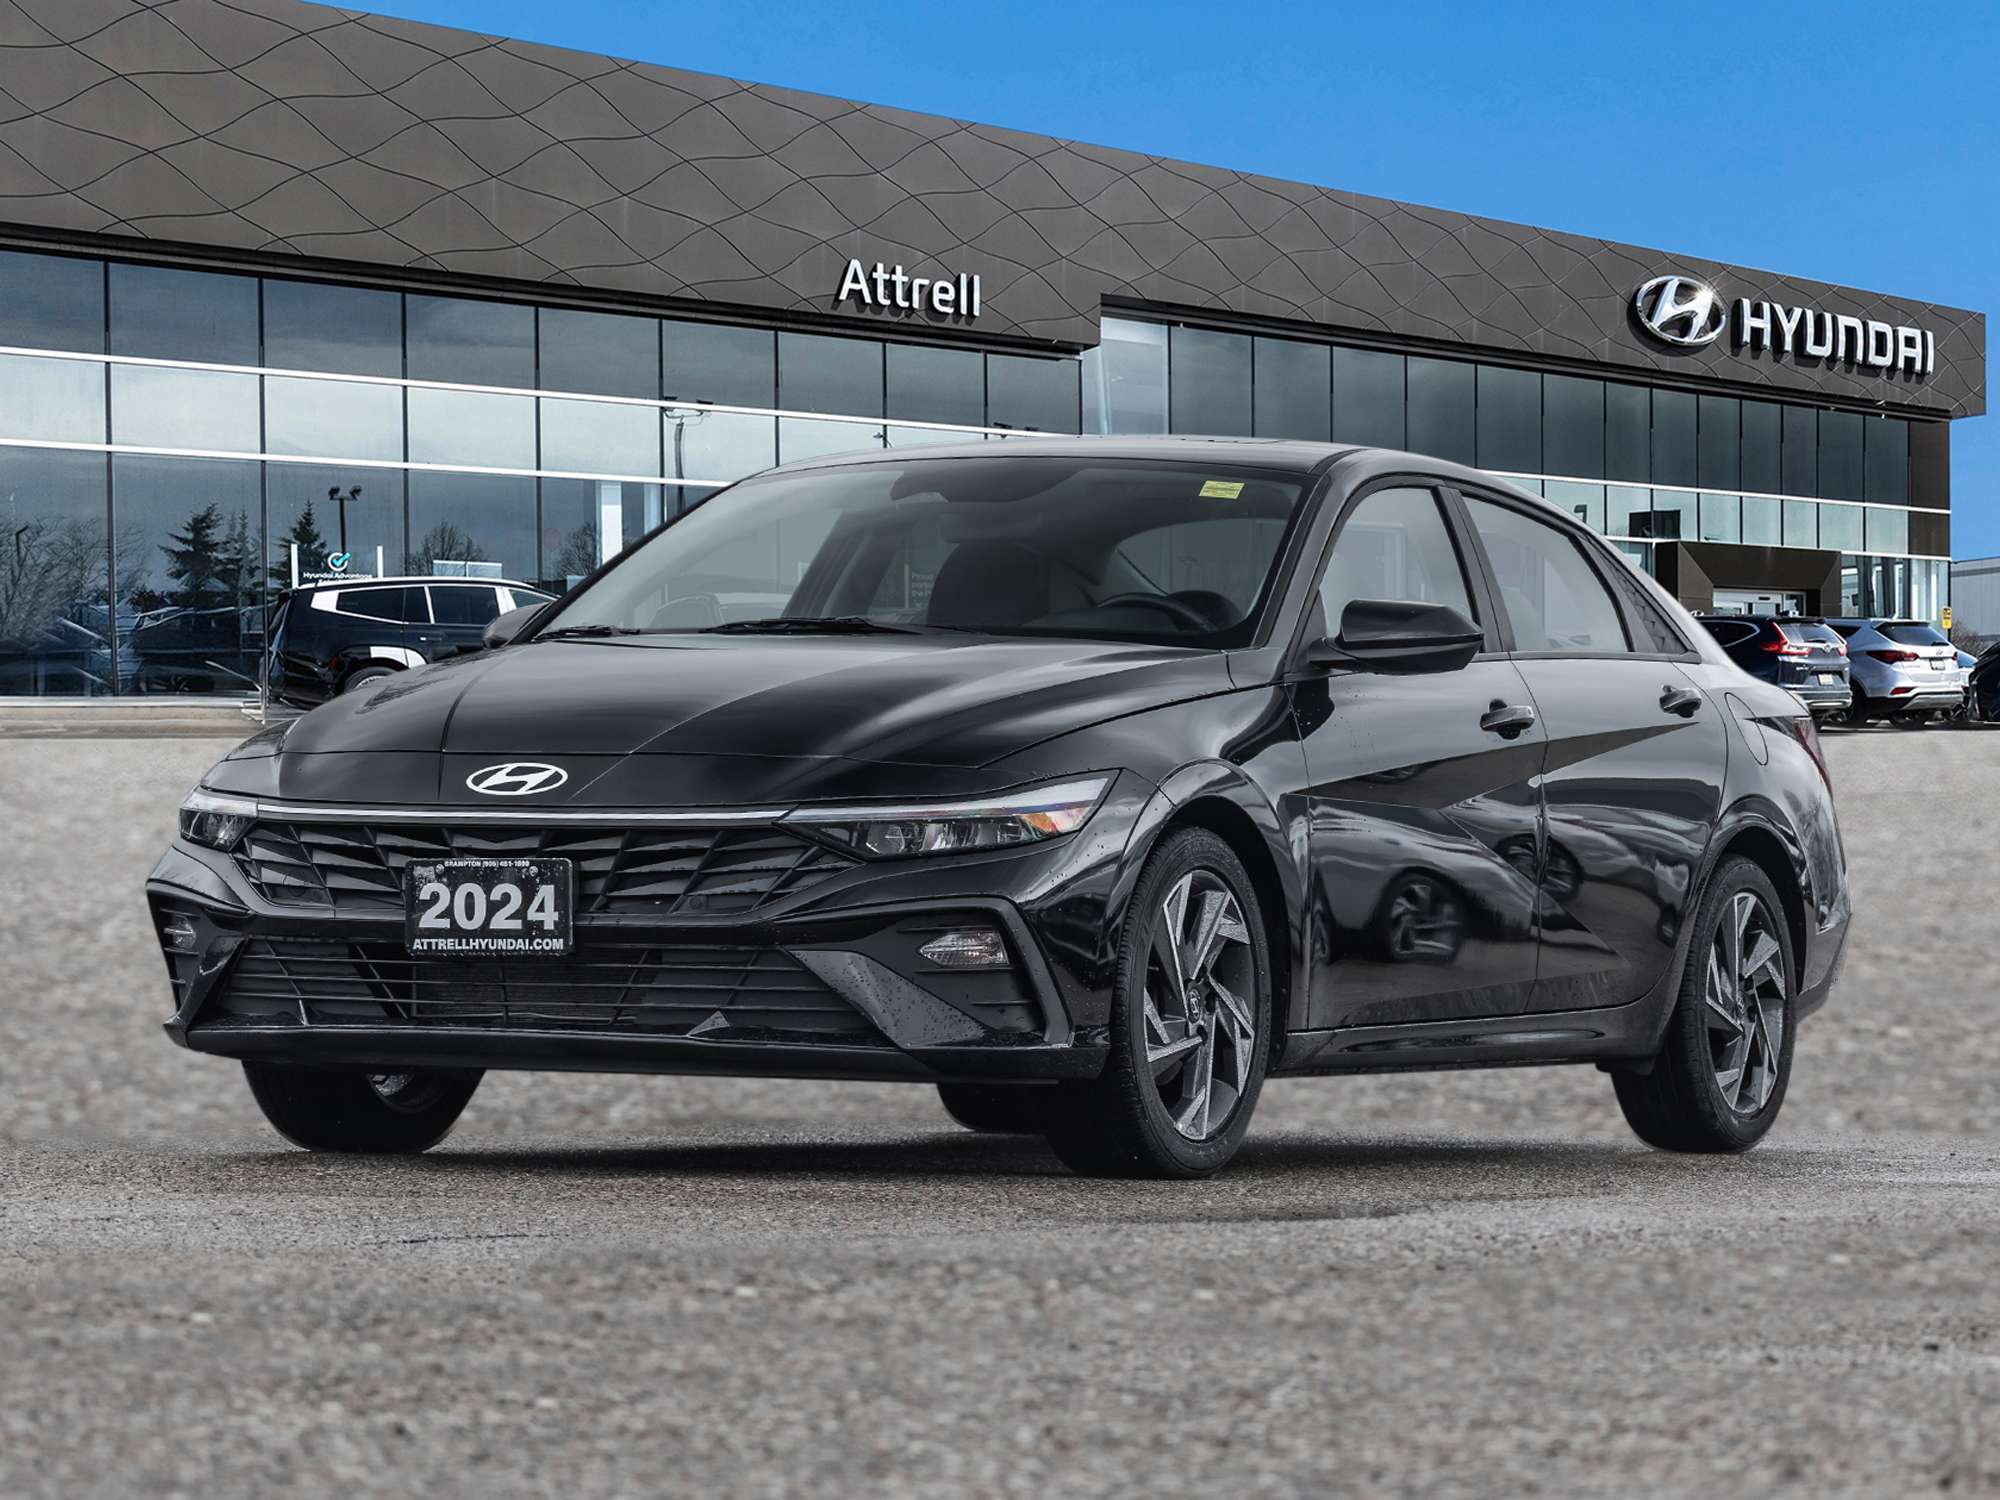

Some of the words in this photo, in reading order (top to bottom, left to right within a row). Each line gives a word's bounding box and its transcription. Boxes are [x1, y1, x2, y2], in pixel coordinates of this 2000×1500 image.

[838, 258, 981, 317] Attrell
[1737, 298, 1935, 375] HYUNDAI
[303, 571, 334, 579] Hyundai
[418, 882, 559, 930] 2024
[413, 938, 564, 950] ATTRELLHYUNDAI.COM
